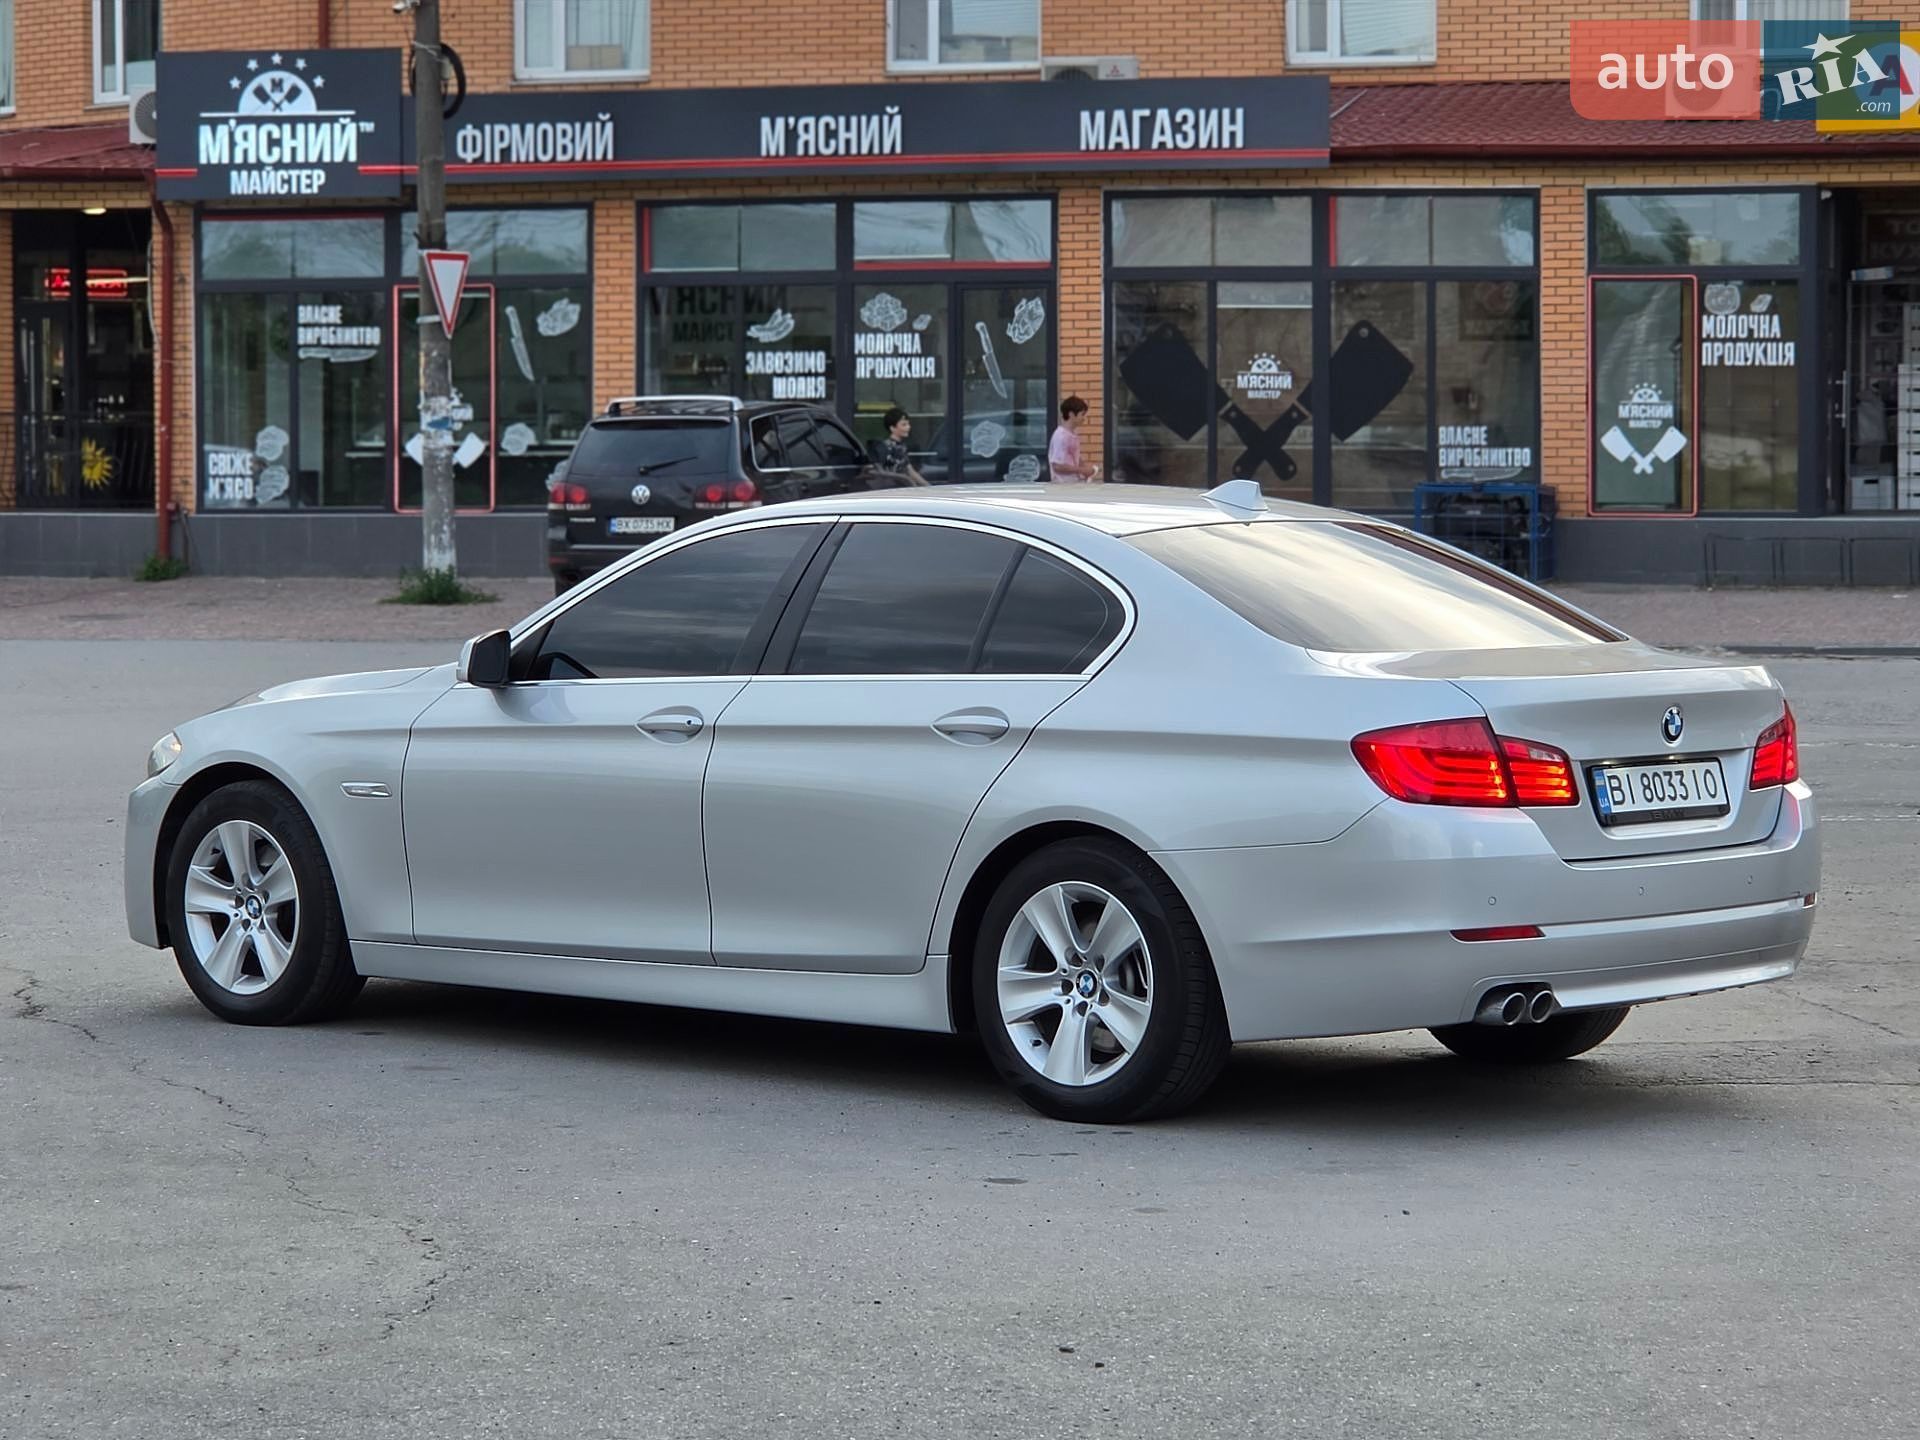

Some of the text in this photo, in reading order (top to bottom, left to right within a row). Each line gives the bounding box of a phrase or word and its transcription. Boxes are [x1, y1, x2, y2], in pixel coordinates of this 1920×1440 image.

[199, 117, 358, 165] М'ЯСНИЙ
[456, 105, 1244, 163] ФІРМОВИЙ М'ЯСНИЙ МАГАЗИН
[230, 166, 326, 195] МАЙСТЕР
[1702, 314, 1781, 339] МОЛОЧНА
[854, 332, 922, 355] МОЛОЧНА
[1702, 341, 1795, 367] ПРОДУКЦІЯ
[745, 350, 826, 374] ЗАВОЗИМО
[855, 356, 936, 379] ПРОДУКЦІЯ
[772, 375, 826, 399] ЩОДНЯ
[1439, 425, 1488, 446] ВЛАСНЕ
[208, 452, 253, 476] СВІЖЕ
[1439, 447, 1531, 467] ВИРОБНИЦТВО
[208, 476, 254, 500] М'ЯСО
[1606, 768, 1717, 806] BI 8033 IO
